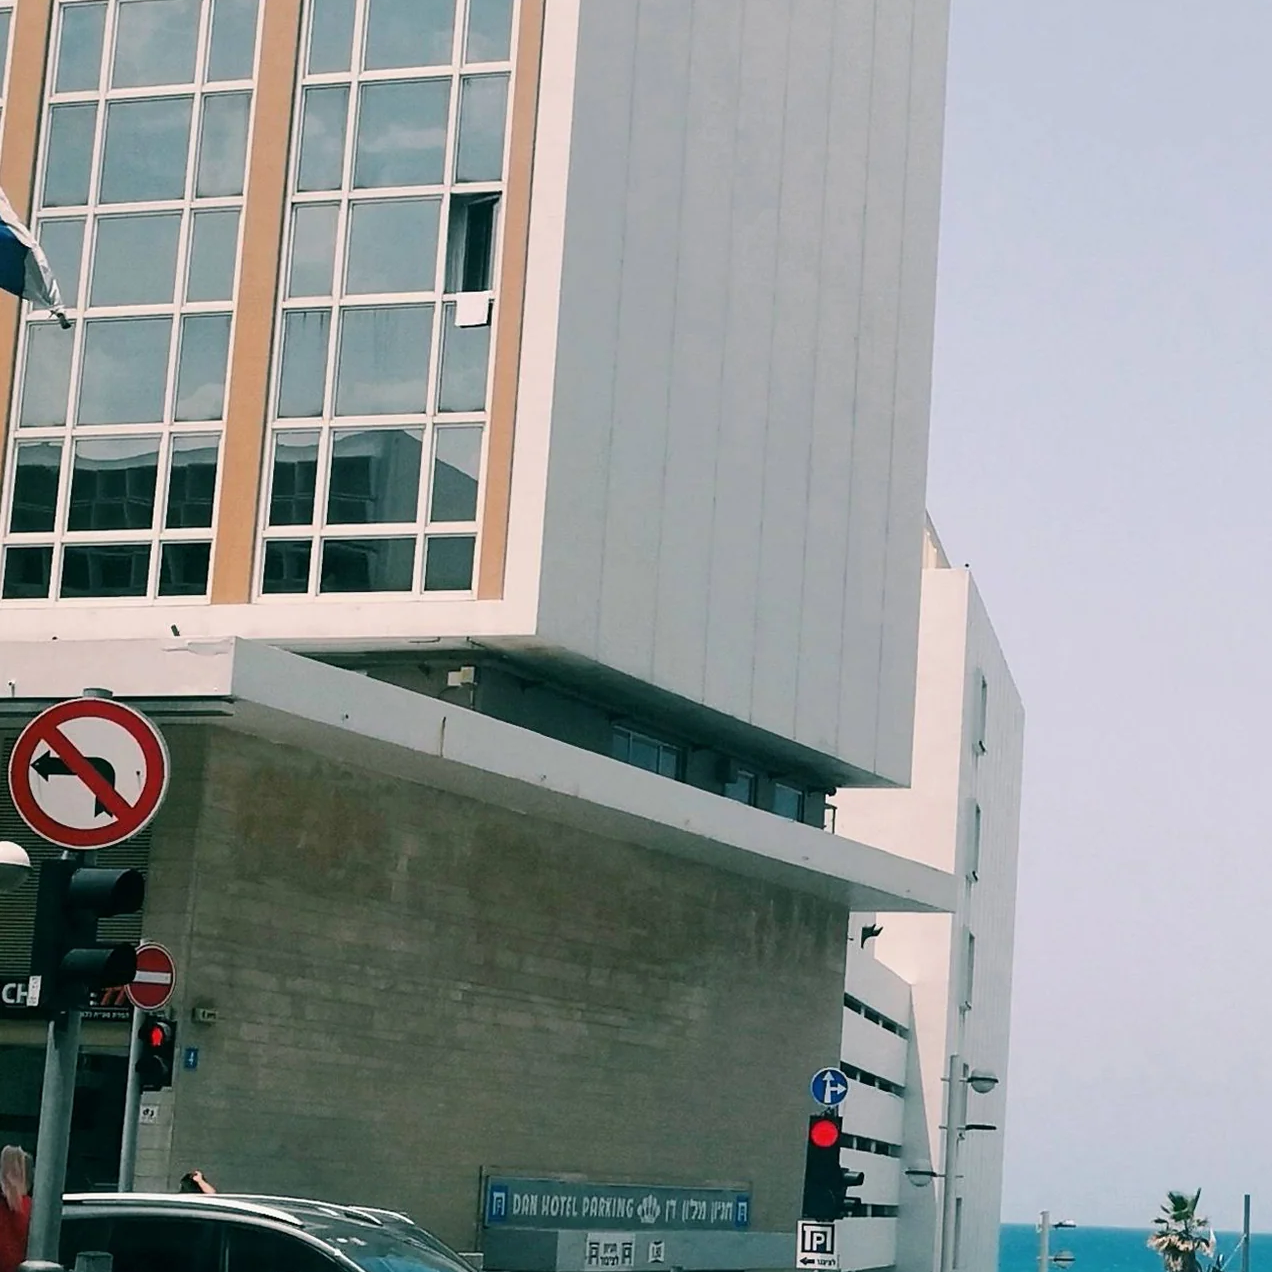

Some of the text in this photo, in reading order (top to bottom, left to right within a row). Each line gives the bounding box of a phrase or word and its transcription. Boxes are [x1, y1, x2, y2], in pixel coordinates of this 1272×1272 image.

[513, 1193, 634, 1219] DAN HOTEL PARKING
[665, 1199, 677, 1222] דן
[682, 1198, 706, 1222] מלון
